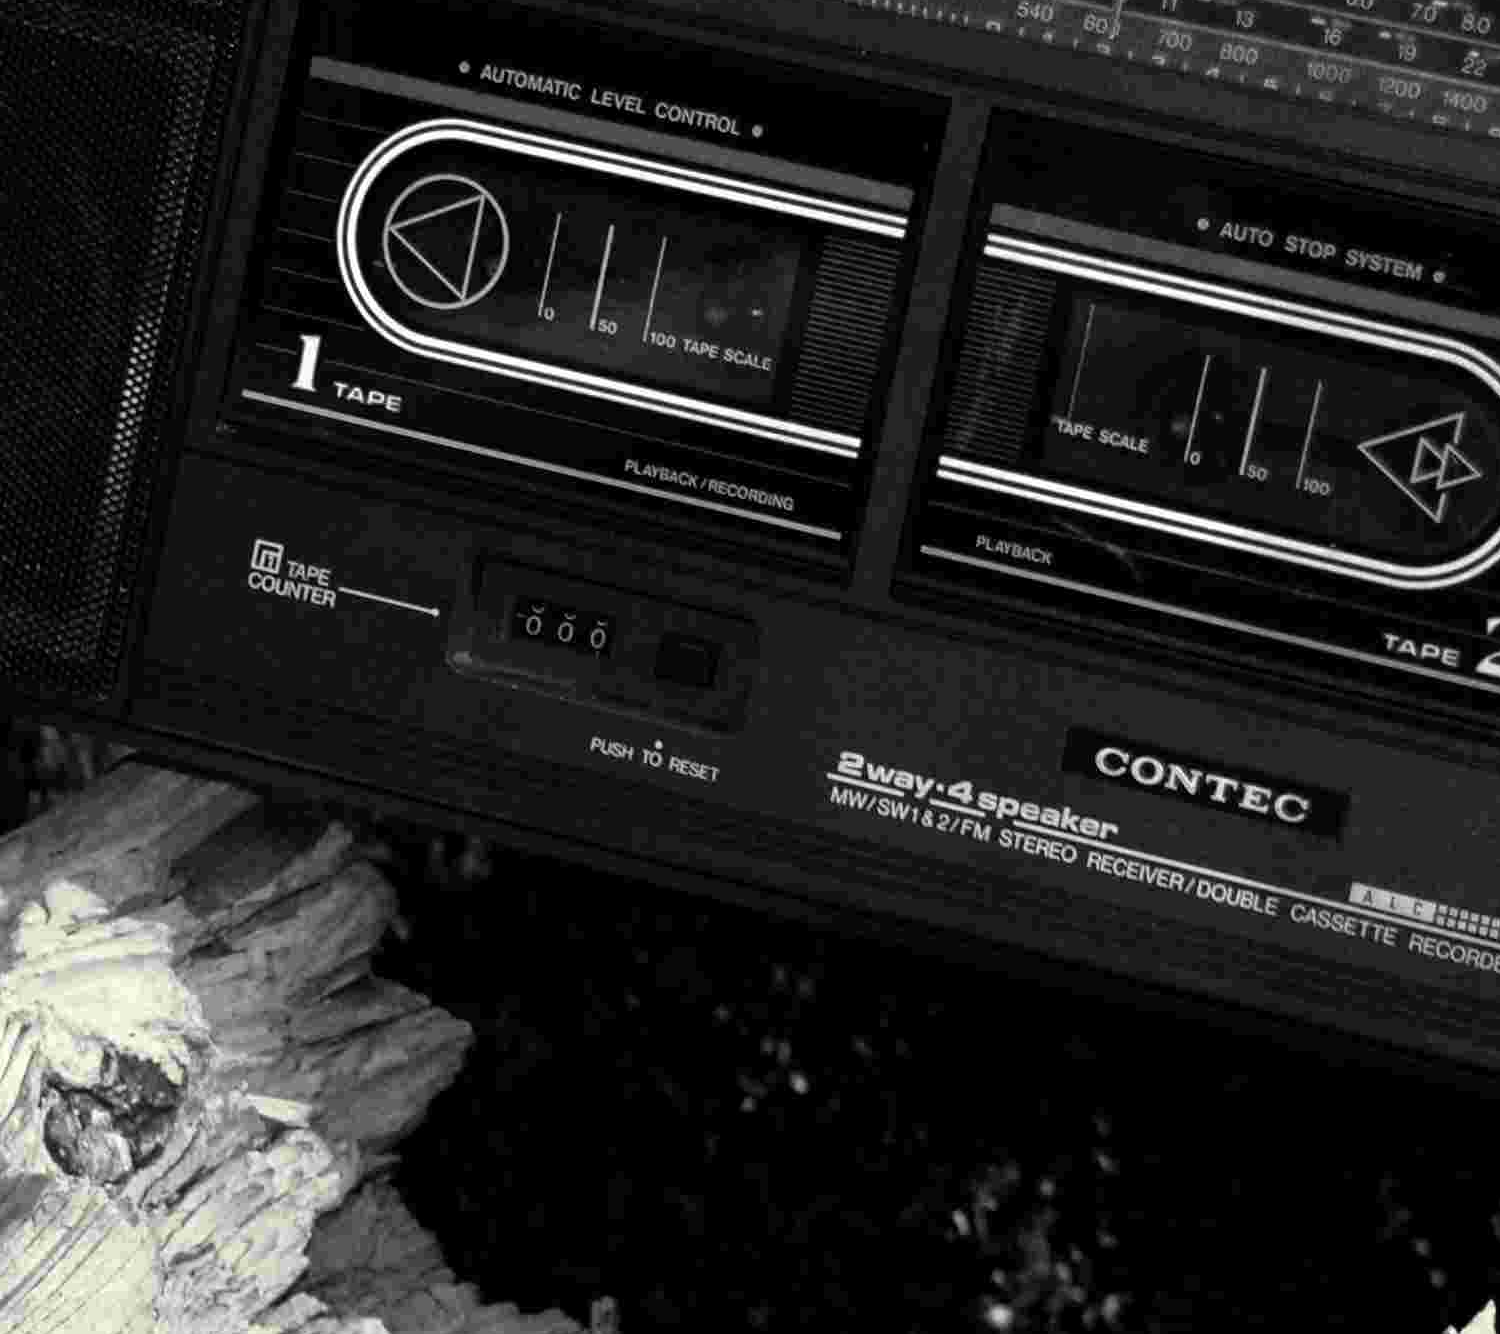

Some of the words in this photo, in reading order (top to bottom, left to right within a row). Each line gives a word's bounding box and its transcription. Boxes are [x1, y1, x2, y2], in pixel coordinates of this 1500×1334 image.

[1017, 2, 1055, 22] 540
[1158, 31, 1194, 52] 700
[1219, 42, 1259, 67] 800
[1306, 60, 1353, 84] 1000
[1378, 76, 1422, 101] 1200
[1441, 88, 1488, 115] 1400
[1236, 9, 1256, 28] 13
[1323, 27, 1343, 47] 16
[1398, 43, 1418, 63] 19
[1459, 56, 1488, 78] 22
[480, 63, 582, 102] AUTOMATIC
[590, 87, 647, 116] LEVEL
[655, 101, 741, 137] CONTROL
[1218, 220, 1275, 248] AUTO
[1283, 234, 1337, 262] STOP
[1345, 247, 1423, 282] SYSTEM
[543, 306, 556, 322] 0
[598, 318, 618, 335] 50
[649, 331, 677, 350] 100
[681, 337, 720, 361] TAPE
[722, 347, 773, 372] SCALE
[292, 333, 321, 393] 1
[333, 381, 404, 413] TAPE
[1055, 417, 1094, 442] TAPE
[1098, 427, 1150, 455] SCALE
[1189, 450, 1202, 466] 0
[1246, 464, 1268, 482] 50
[1302, 477, 1332, 498] 100
[286, 559, 332, 588] TAPE
[975, 533, 1053, 566] PLAYBACK
[247, 570, 338, 610] COUNTER
[1383, 632, 1461, 668] TAPE
[589, 735, 635, 763] PUSH
[641, 749, 663, 768] TO
[667, 754, 721, 783] RESET
[1093, 745, 1312, 824] CONTEC
[998, 826, 1079, 863] STEREO
[1289, 901, 1399, 948] CASSETTE
